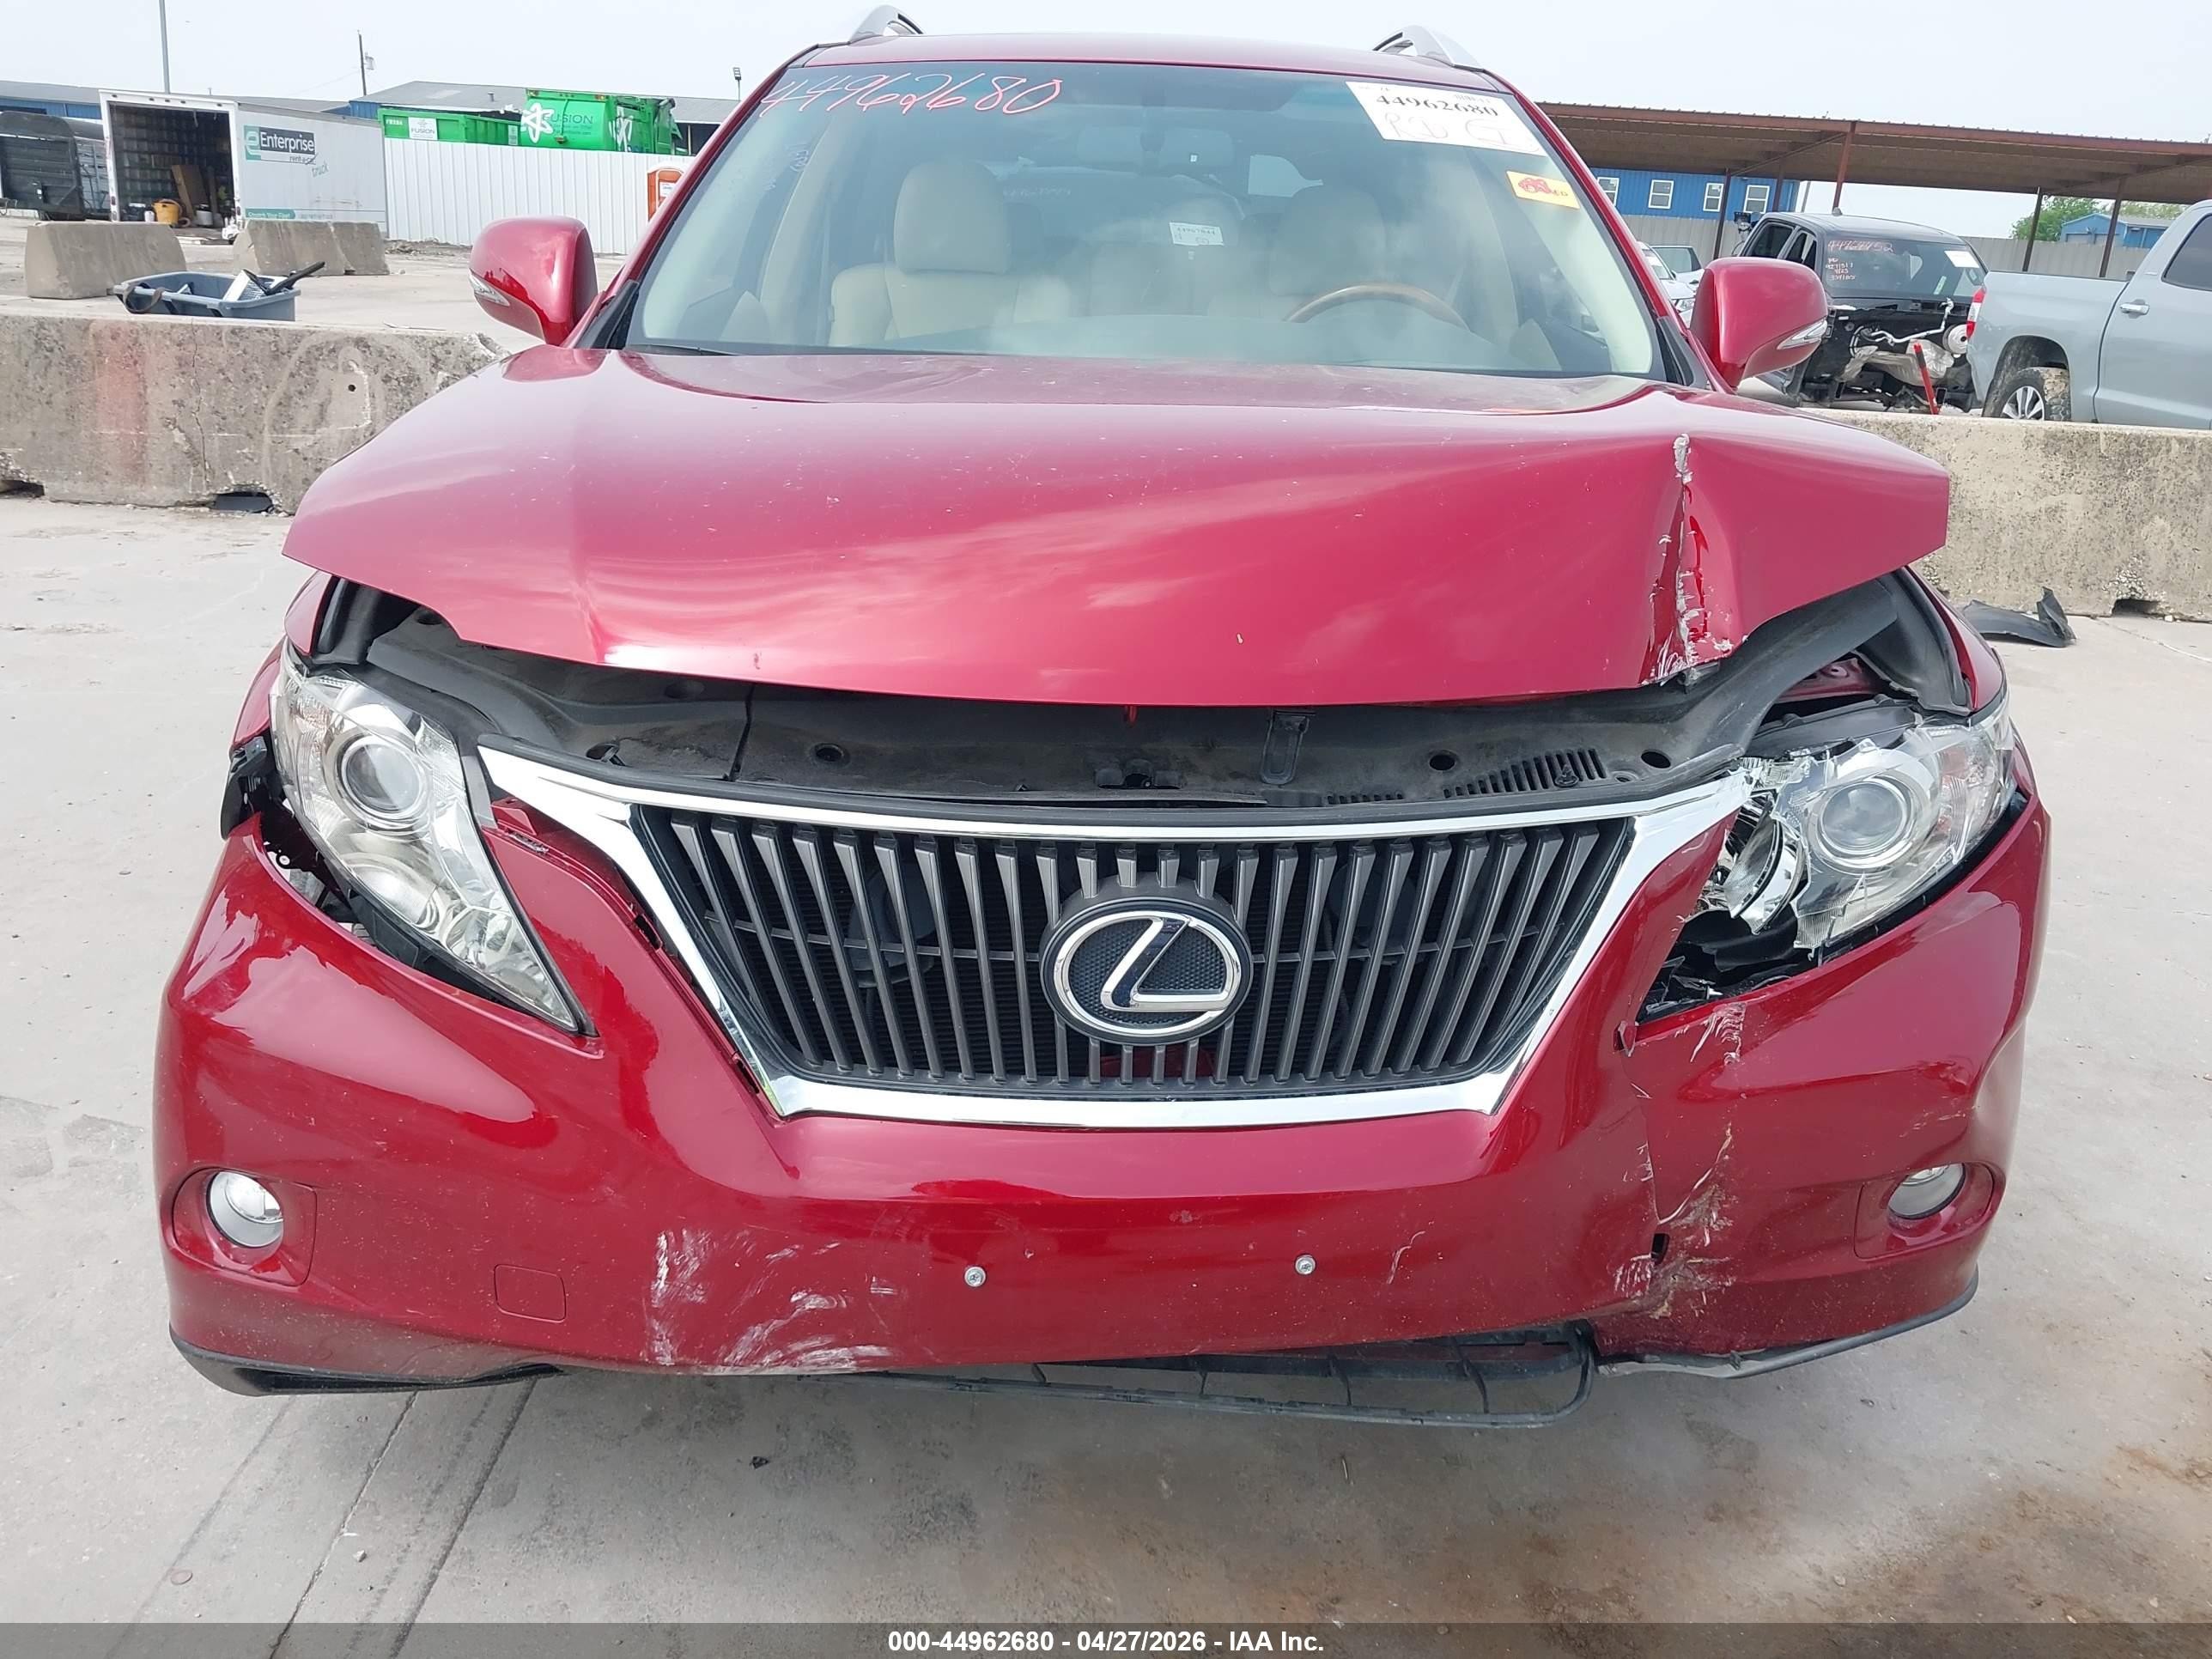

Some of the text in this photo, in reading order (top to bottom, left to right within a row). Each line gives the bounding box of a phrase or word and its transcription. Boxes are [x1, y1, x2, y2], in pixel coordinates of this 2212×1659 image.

[760, 72, 1064, 118] 44962680
[1376, 94, 1499, 118] 44962680
[260, 131, 315, 153] Enterprise
